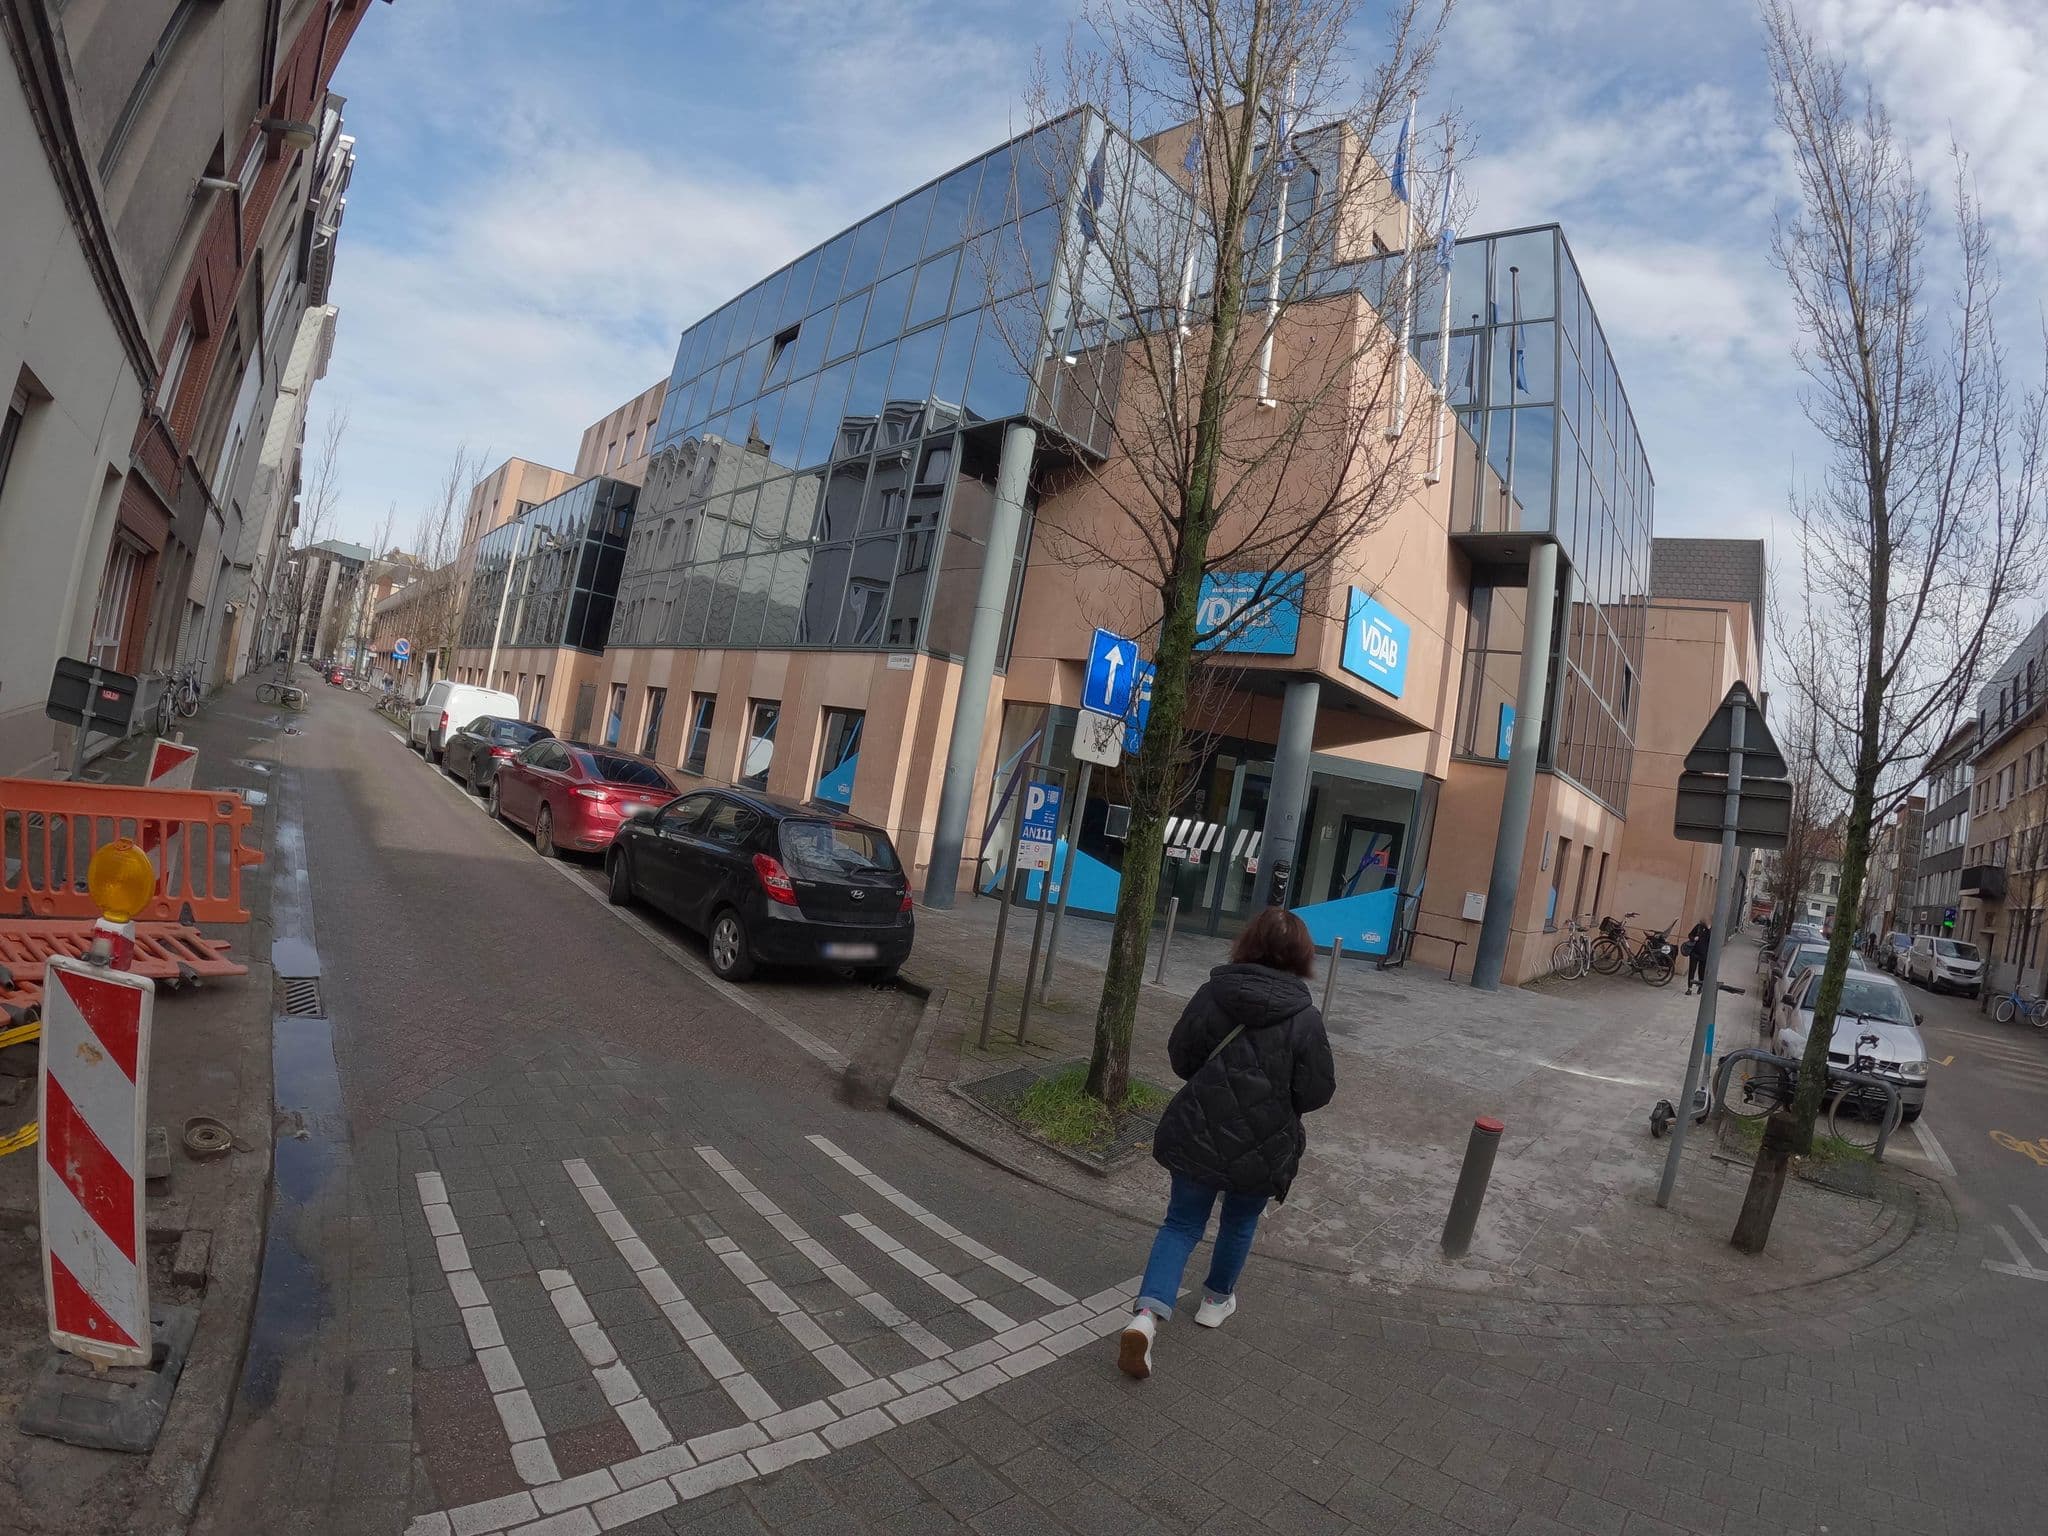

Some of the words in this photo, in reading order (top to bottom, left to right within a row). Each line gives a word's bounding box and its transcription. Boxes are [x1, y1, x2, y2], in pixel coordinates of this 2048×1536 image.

[1362, 619, 1398, 668] VDAB
[1025, 786, 1045, 820] P
[1022, 826, 1052, 841] AN111
[1361, 932, 1381, 943] VDAB
